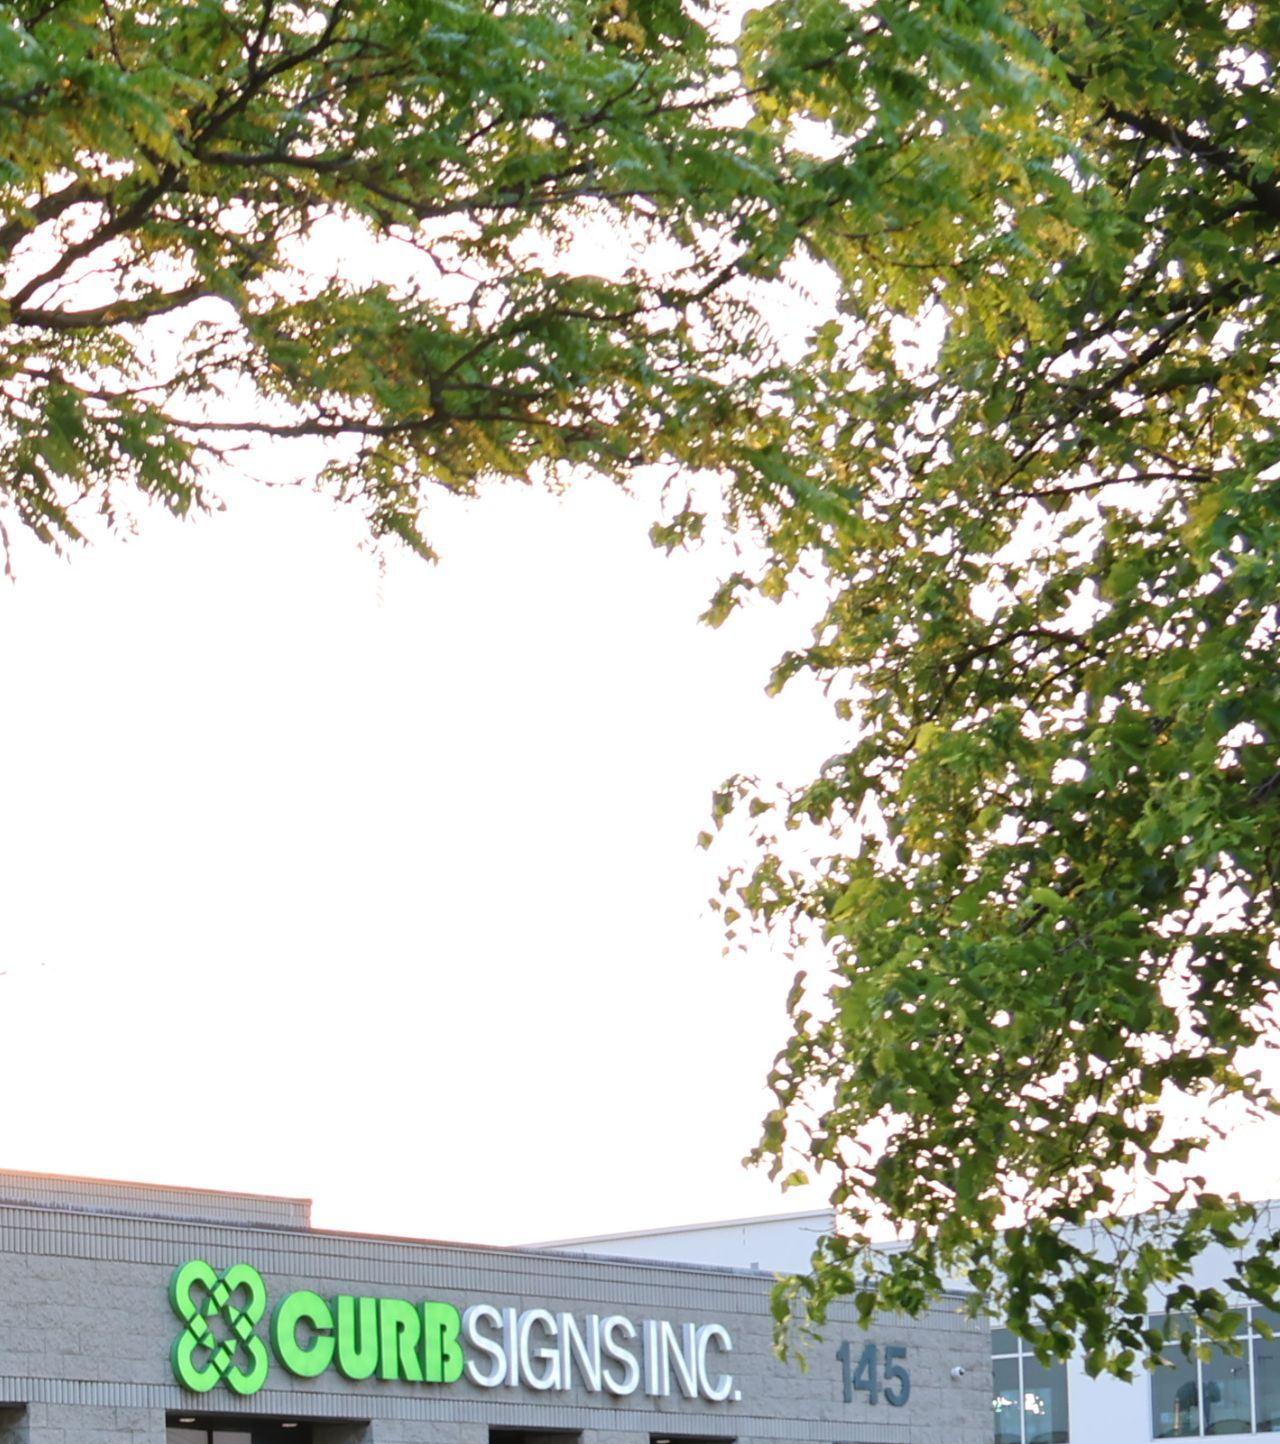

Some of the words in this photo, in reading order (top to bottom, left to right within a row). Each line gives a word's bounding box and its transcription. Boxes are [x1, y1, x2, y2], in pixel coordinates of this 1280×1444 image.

[271, 1290, 640, 1396] CURBSIGNS
[644, 1319, 742, 1401] INC.
[836, 1340, 911, 1407] 145
